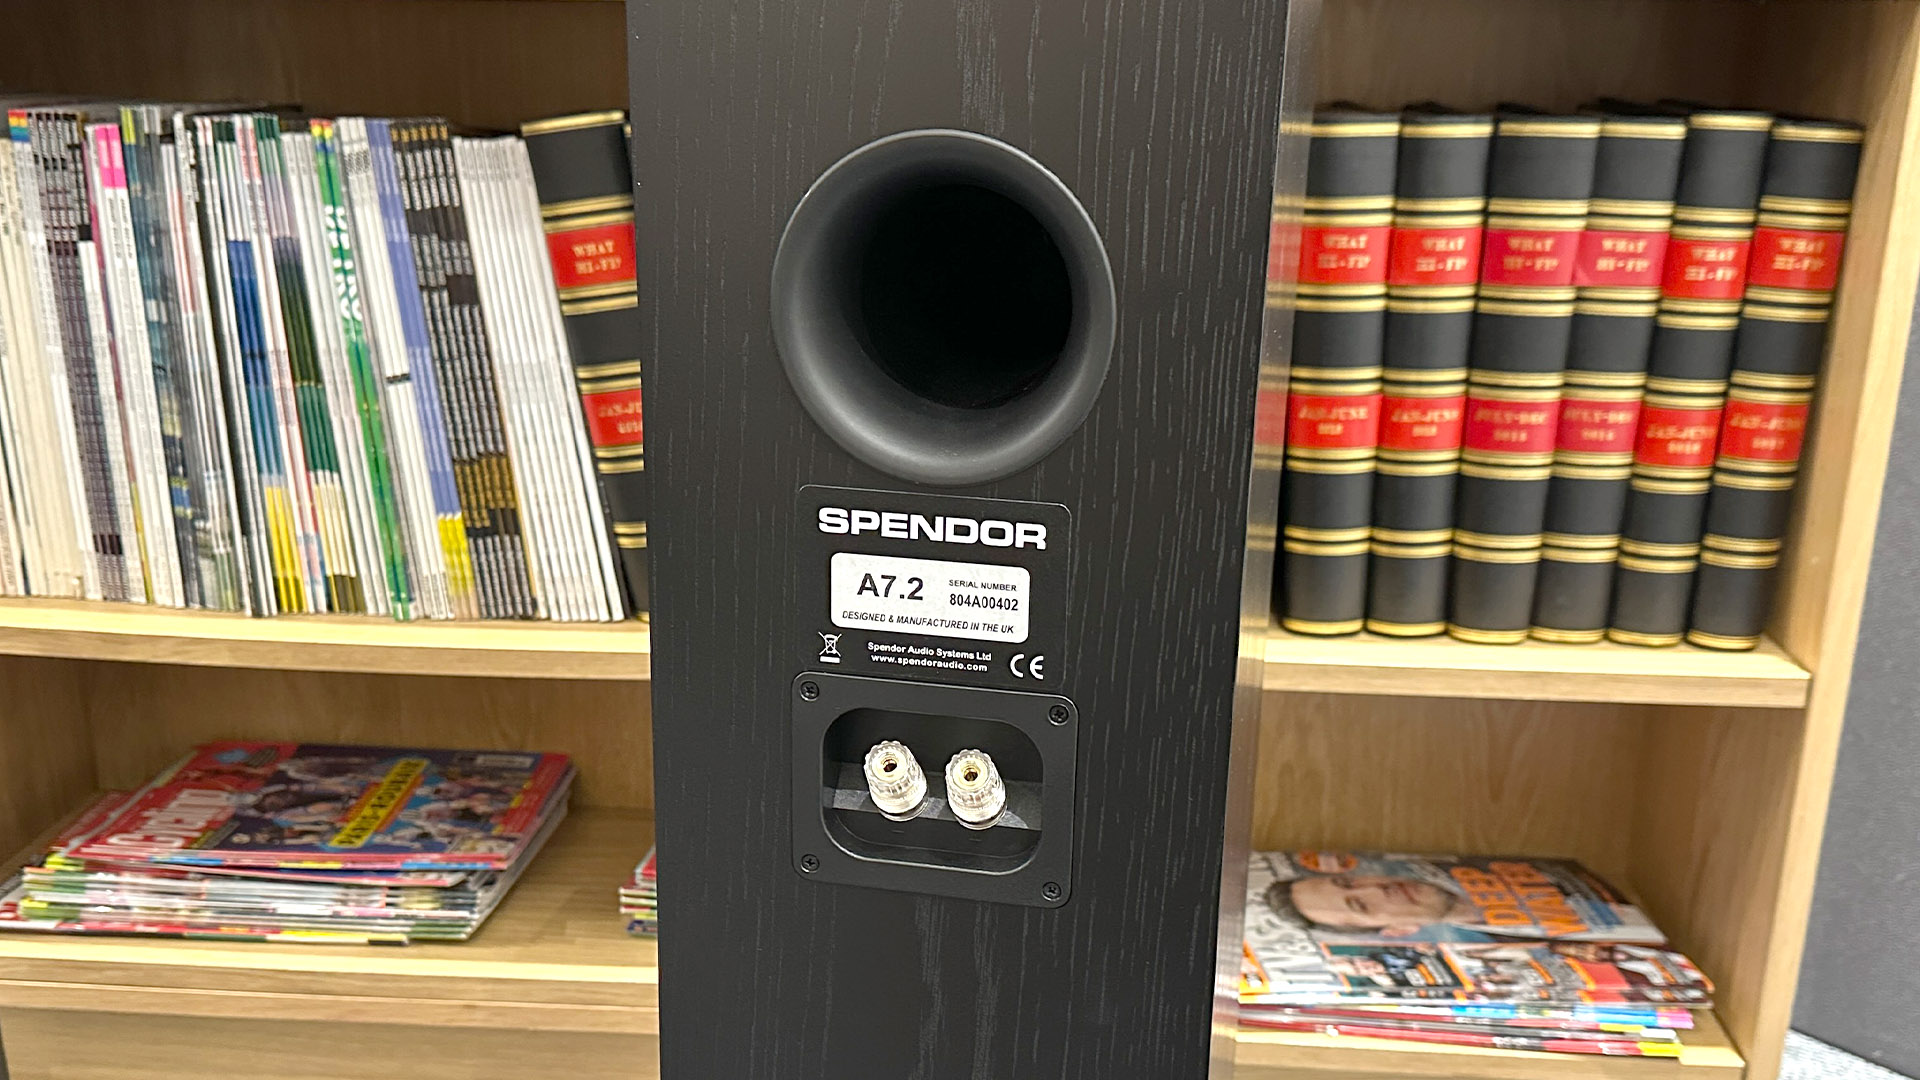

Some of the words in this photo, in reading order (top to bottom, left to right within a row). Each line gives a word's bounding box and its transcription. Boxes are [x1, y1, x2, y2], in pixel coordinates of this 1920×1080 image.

[818, 507, 1047, 550] SPENDOR
[857, 573, 924, 600] A7.2
[949, 579, 979, 589] SERIAL
[980, 581, 1017, 592] NUMBER
[949, 594, 1019, 611] 804A00402
[842, 610, 886, 623] DESIGNED
[888, 614, 895, 623] &
[896, 616, 968, 630] MANUFACTURED
[970, 622, 980, 631] IN
[981, 623, 999, 633] THE
[1000, 624, 1014, 634] UK
[867, 641, 906, 654] Spendor
[908, 645, 935, 656] Audio
[936, 648, 975, 660] Systems
[976, 651, 992, 662] Ltd
[870, 654, 988, 672] www.spendoraudio.com
